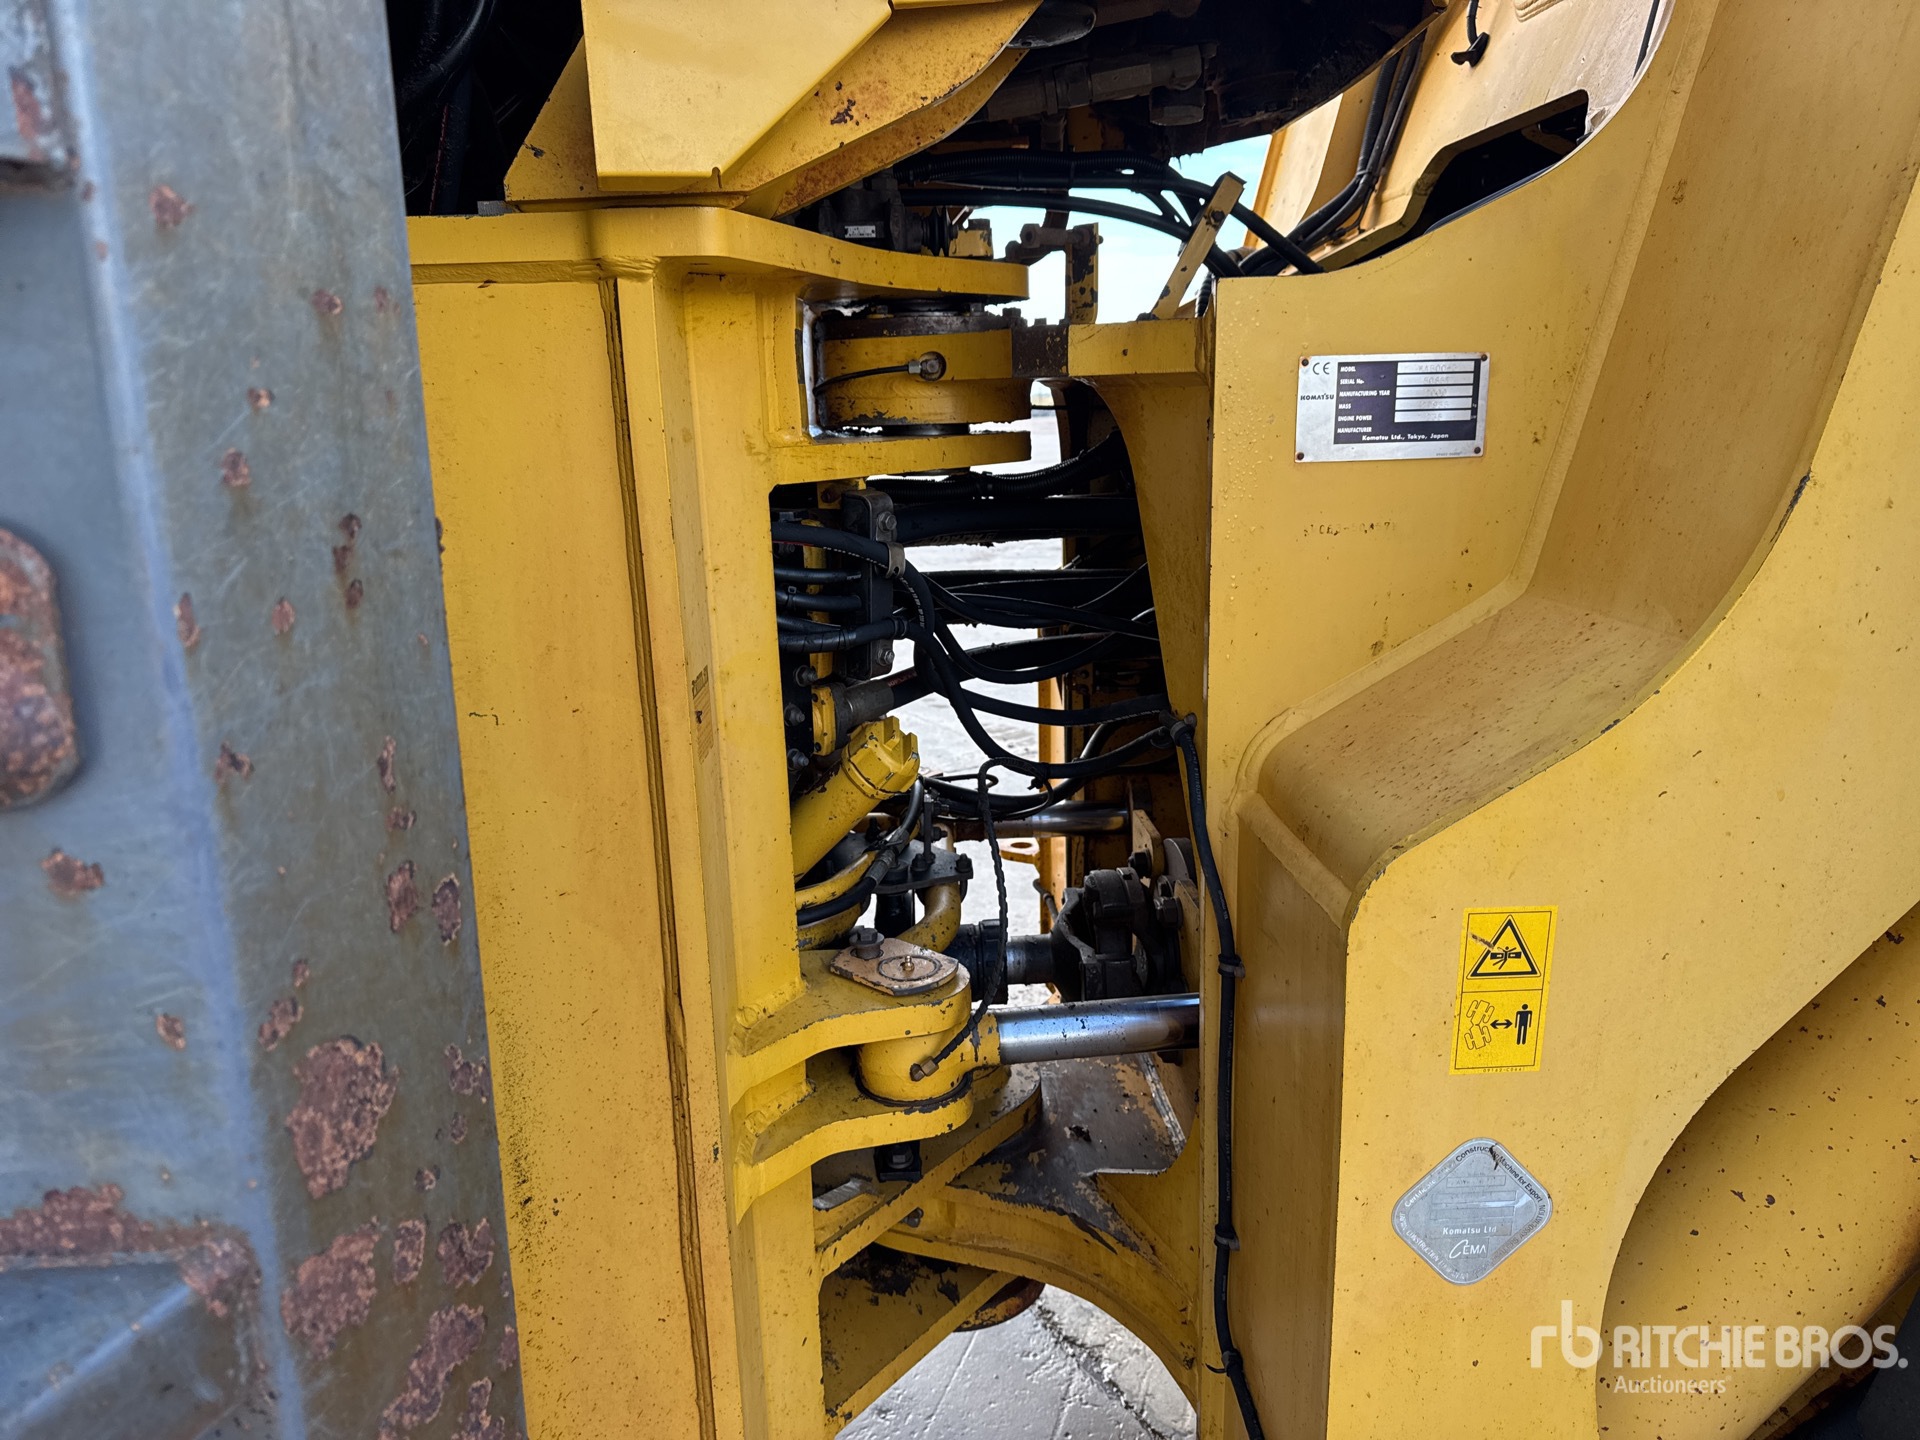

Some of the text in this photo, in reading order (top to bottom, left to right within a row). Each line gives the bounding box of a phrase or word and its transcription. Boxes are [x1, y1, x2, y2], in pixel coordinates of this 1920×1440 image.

[1300, 392, 1335, 401] KOMATSU
[1337, 426, 1373, 434] MANUFACTURER
[1429, 432, 1449, 440] Japan
[1516, 1175, 1527, 1187] for
[1524, 1182, 1543, 1203] Export
[1442, 1226, 1481, 1236] Komatsu
[1448, 1239, 1487, 1259] CEMA
